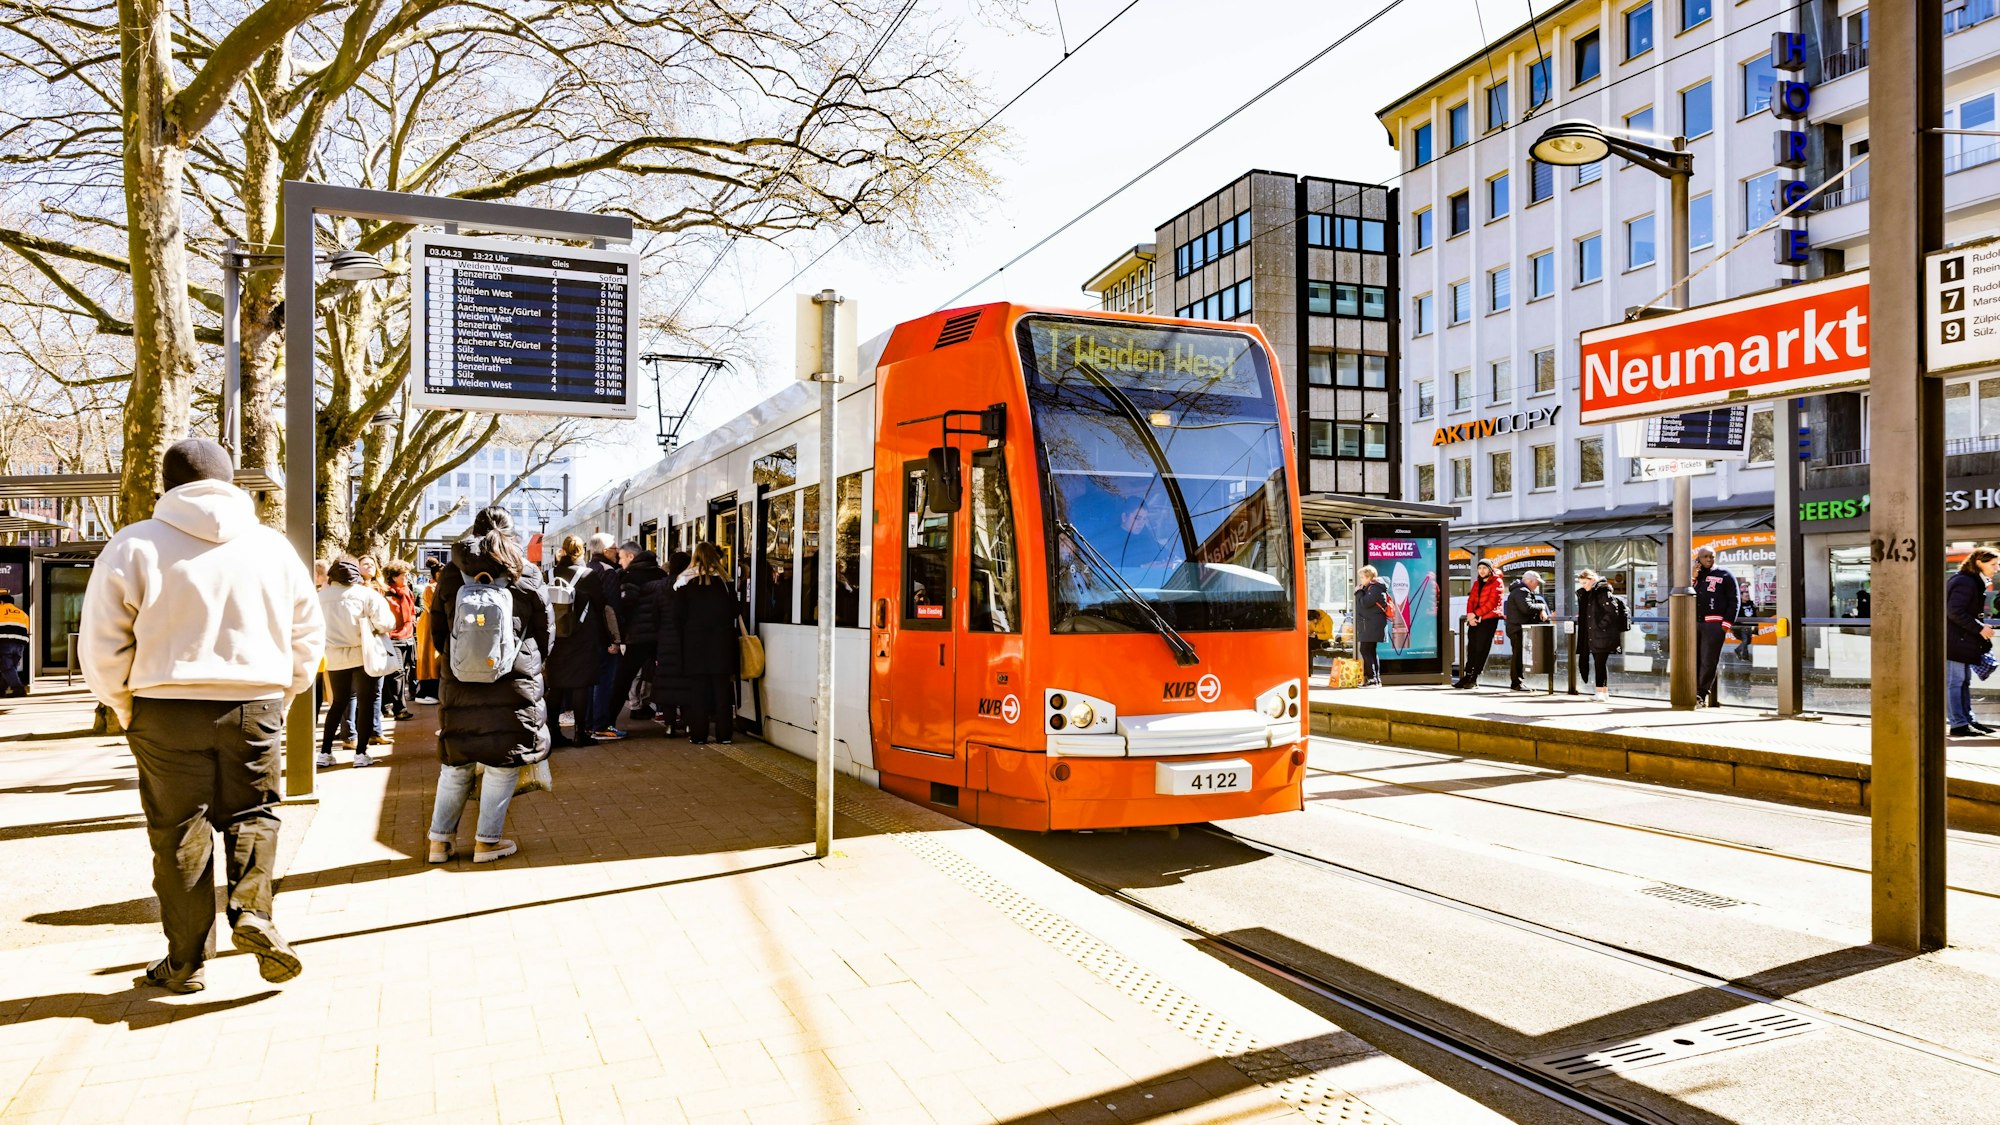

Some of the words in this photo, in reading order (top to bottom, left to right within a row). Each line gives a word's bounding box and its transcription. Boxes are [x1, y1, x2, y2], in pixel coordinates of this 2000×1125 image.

[429, 248, 461, 257] 03.04.23
[457, 260, 489, 270] Weiden
[491, 264, 512, 272] West
[599, 274, 622, 282] Sofort
[457, 269, 501, 280] Benzelrath
[1946, 260, 1956, 279] 1
[457, 277, 474, 286] Sülz
[457, 286, 489, 296] Weiden
[491, 289, 512, 297] West
[457, 294, 474, 303] Sülz
[1945, 290, 1960, 310] 7
[457, 303, 497, 313] Aachener
[498, 306, 540, 317] Str./Gürtel
[457, 312, 489, 321] Weiden
[491, 314, 512, 322] West
[457, 320, 501, 330] Benzelrath
[1946, 322, 1960, 340] 9
[457, 328, 489, 337] Weiden
[491, 331, 512, 339] West
[457, 337, 496, 346] Aachener
[498, 339, 540, 350] Str./Gürtel
[457, 345, 474, 353] Sülz
[457, 354, 489, 362] Weiden
[1075, 335, 1164, 374] Weiden
[1175, 342, 1236, 378] West
[1584, 305, 1867, 400] Neumarkt
[457, 362, 500, 371] Benzelrath
[457, 370, 474, 378] Sülz
[457, 379, 489, 387] Weiden
[1870, 538, 1916, 562] 343
[1503, 560, 1536, 572] STUDENTEN
[1706, 576, 1723, 592] T
[1163, 682, 1196, 698] KVB
[978, 698, 1002, 715] KVB
[1192, 772, 1237, 789] 4122
